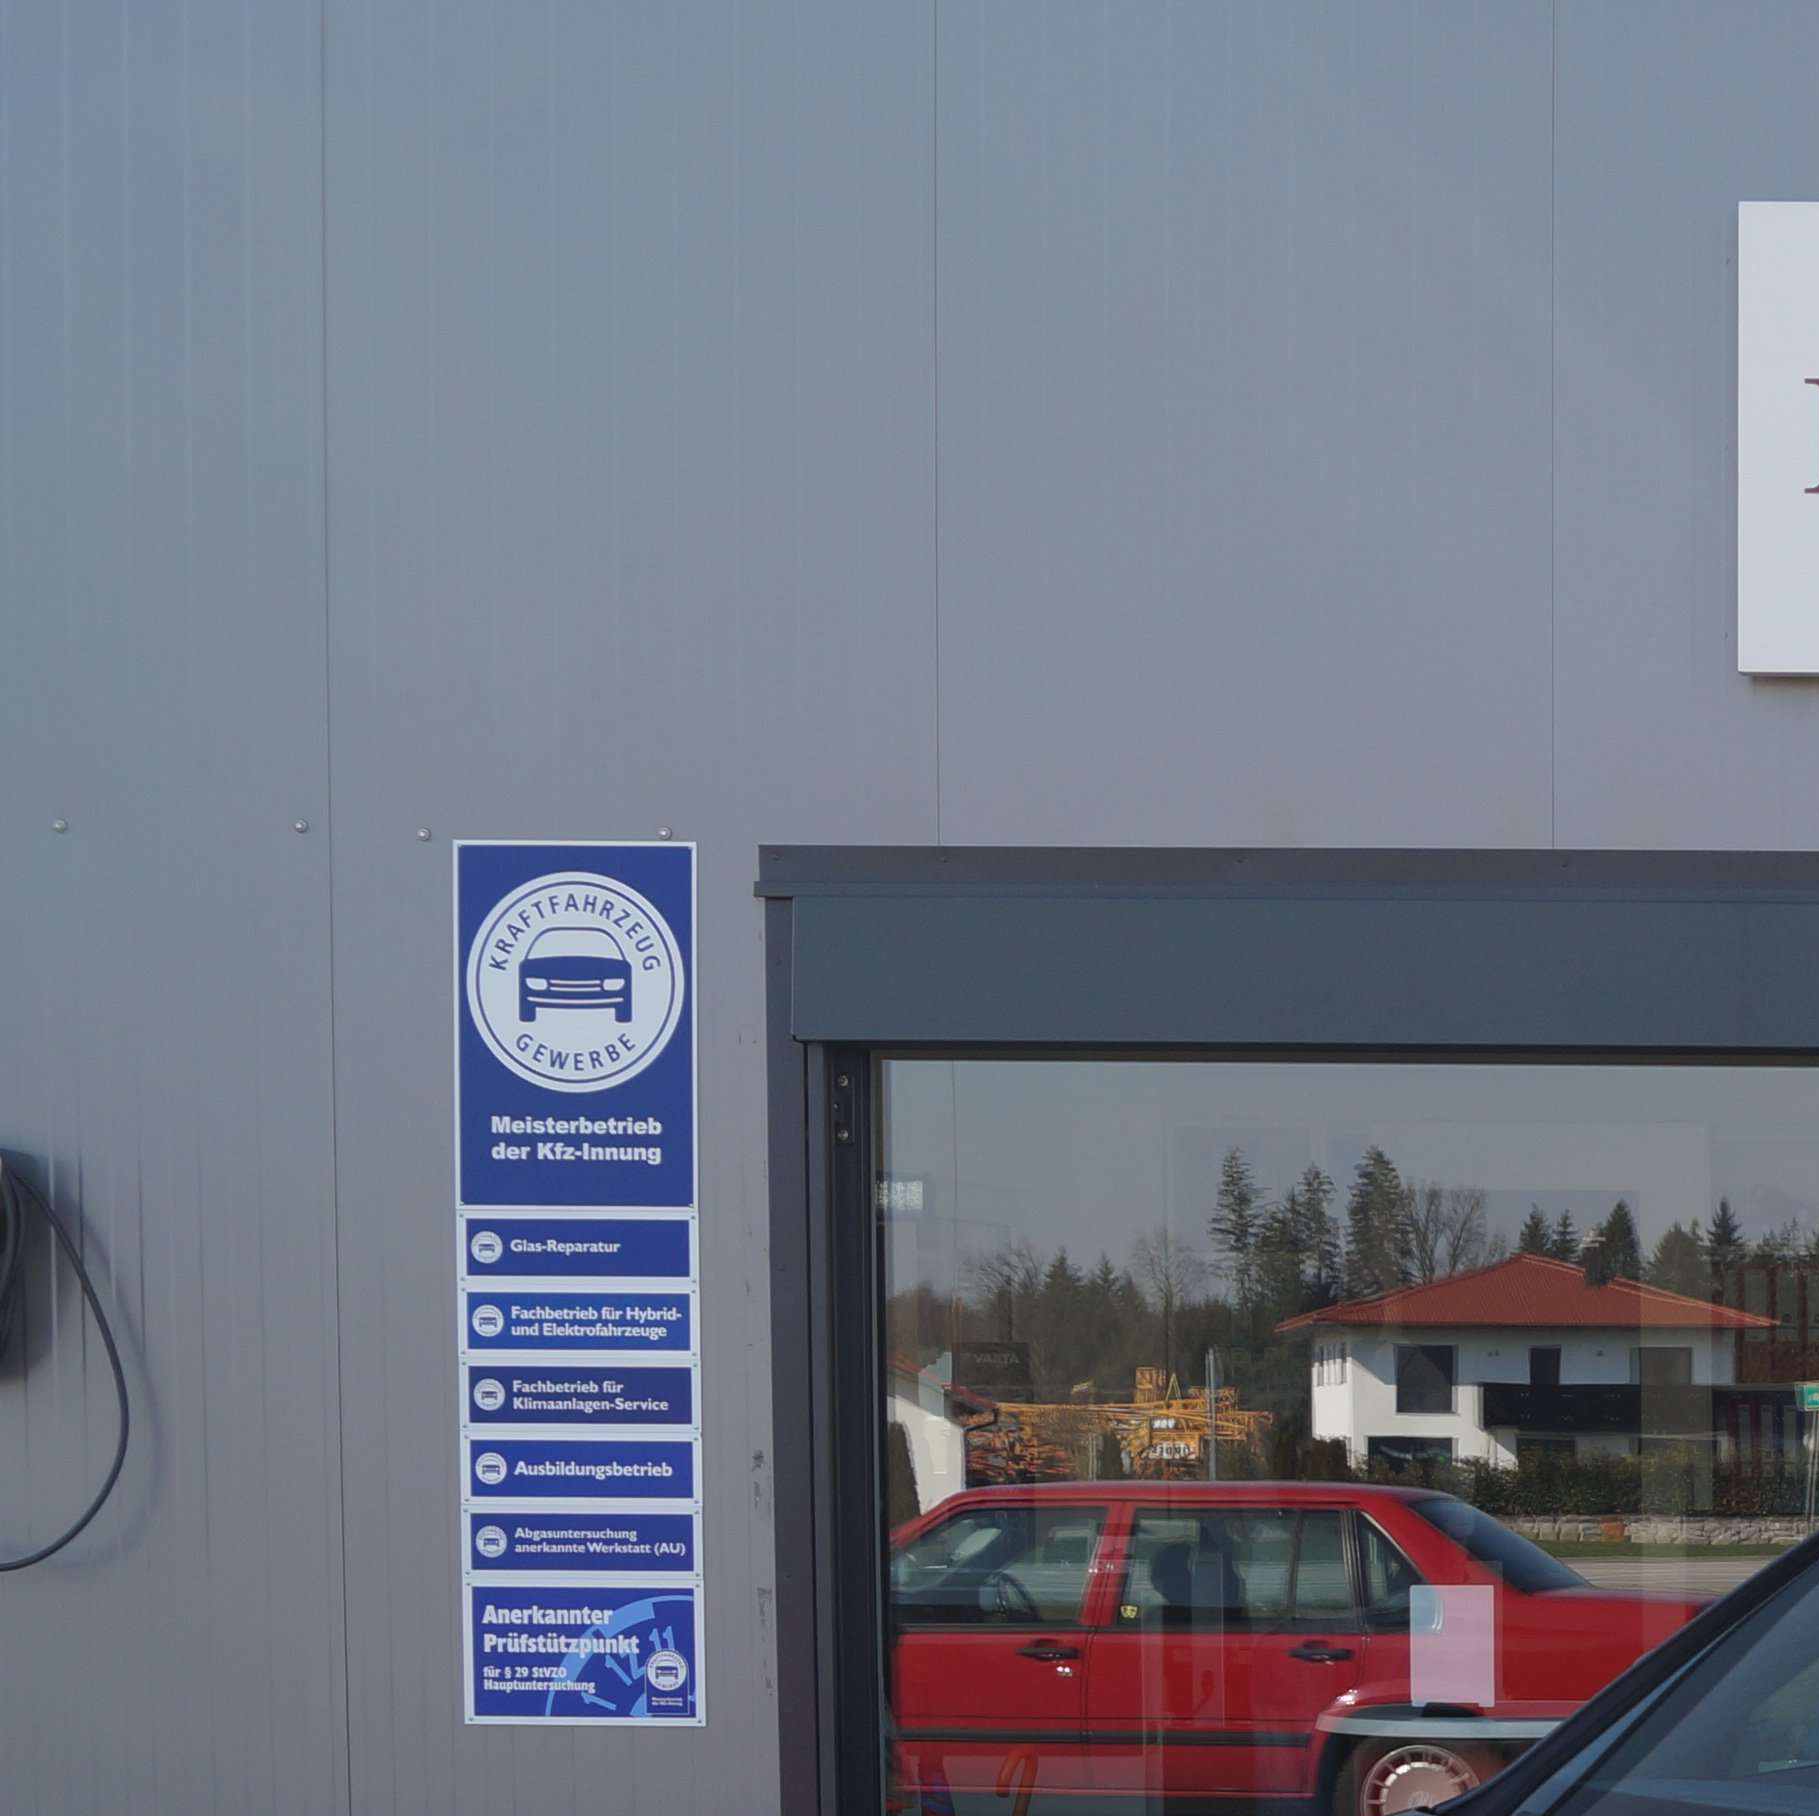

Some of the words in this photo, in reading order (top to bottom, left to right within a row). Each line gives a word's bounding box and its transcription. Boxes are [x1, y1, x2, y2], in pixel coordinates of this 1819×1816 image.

[488, 893, 662, 971] KRAFTFAHRZEUG
[515, 1033, 636, 1071] GEWERBE
[491, 1115, 662, 1136] Meisterbetrieb
[491, 1143, 531, 1160] der
[537, 1143, 662, 1165] Kfz-Innung
[510, 1239, 621, 1256] Glas-Reparatur
[511, 1306, 597, 1320] Fachbetrieb
[601, 1307, 623, 1320] für
[626, 1307, 682, 1324] Hybrid-
[511, 1323, 539, 1336] und
[543, 1323, 667, 1340] Elektrofahrzeuge
[512, 1380, 598, 1393] Fachbetrieb
[602, 1381, 624, 1394] für
[513, 1397, 669, 1413] Klimaanlagen-Service
[514, 1461, 673, 1480] Ausbildungsbetrieb
[514, 1528, 637, 1541] Abgasuntersuchung
[515, 1542, 586, 1553] anerkannte
[588, 1542, 651, 1554] Werkstatt
[654, 1542, 686, 1556] (AU)
[482, 1605, 613, 1625] Anerkannter
[483, 1632, 640, 1658] Prüfstützpunkt
[483, 1666, 501, 1678] für
[514, 1666, 528, 1678] 29
[532, 1666, 567, 1678] StVZO
[484, 1679, 596, 1694] Hauptuntersuchung
